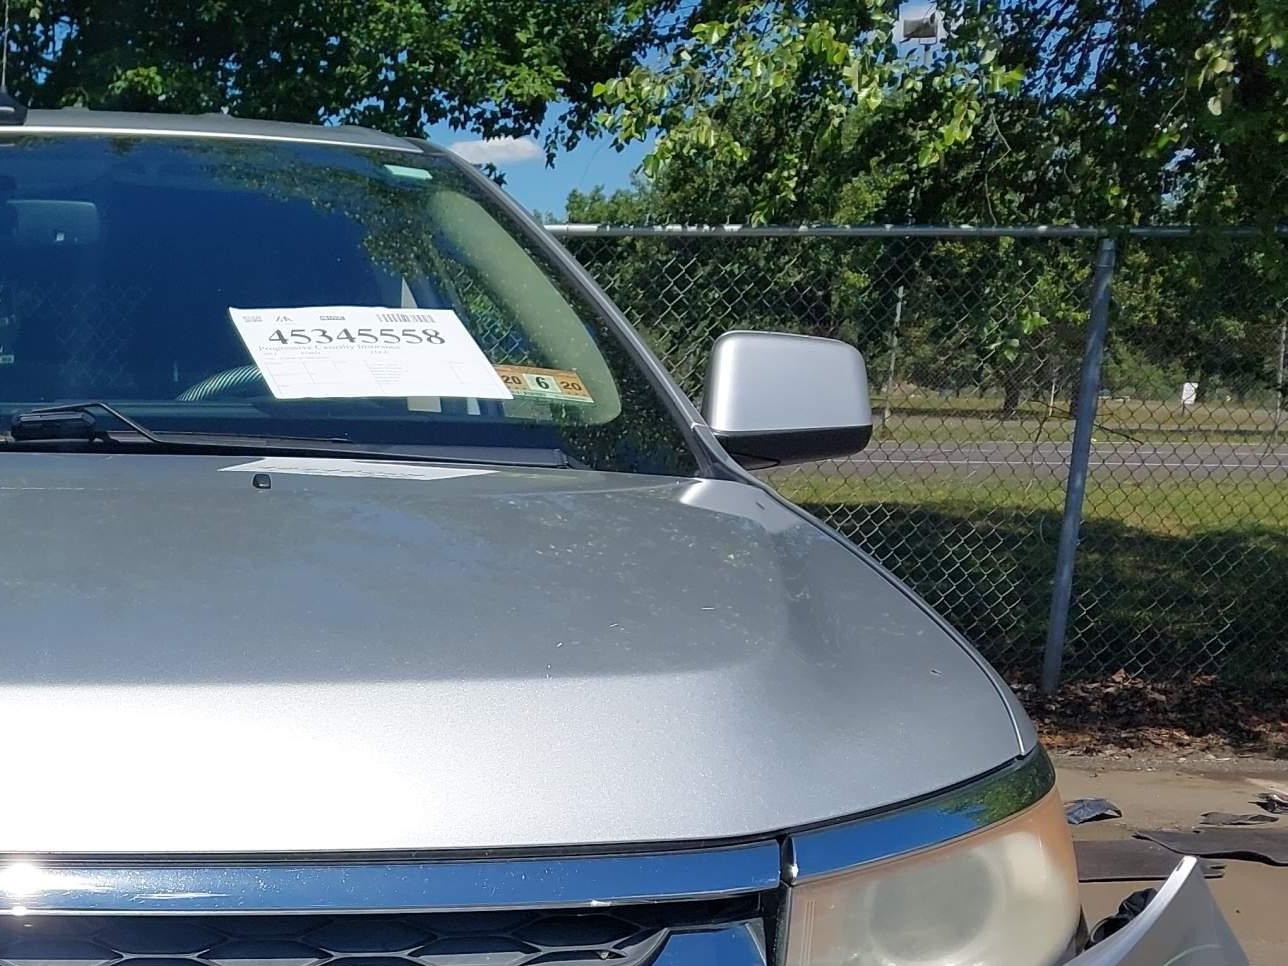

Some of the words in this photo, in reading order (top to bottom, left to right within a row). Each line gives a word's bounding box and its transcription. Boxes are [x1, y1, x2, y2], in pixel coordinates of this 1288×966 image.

[268, 328, 446, 345] 45345558
[501, 375, 522, 385] 20
[535, 376, 550, 390] 6
[560, 381, 582, 391] 20
